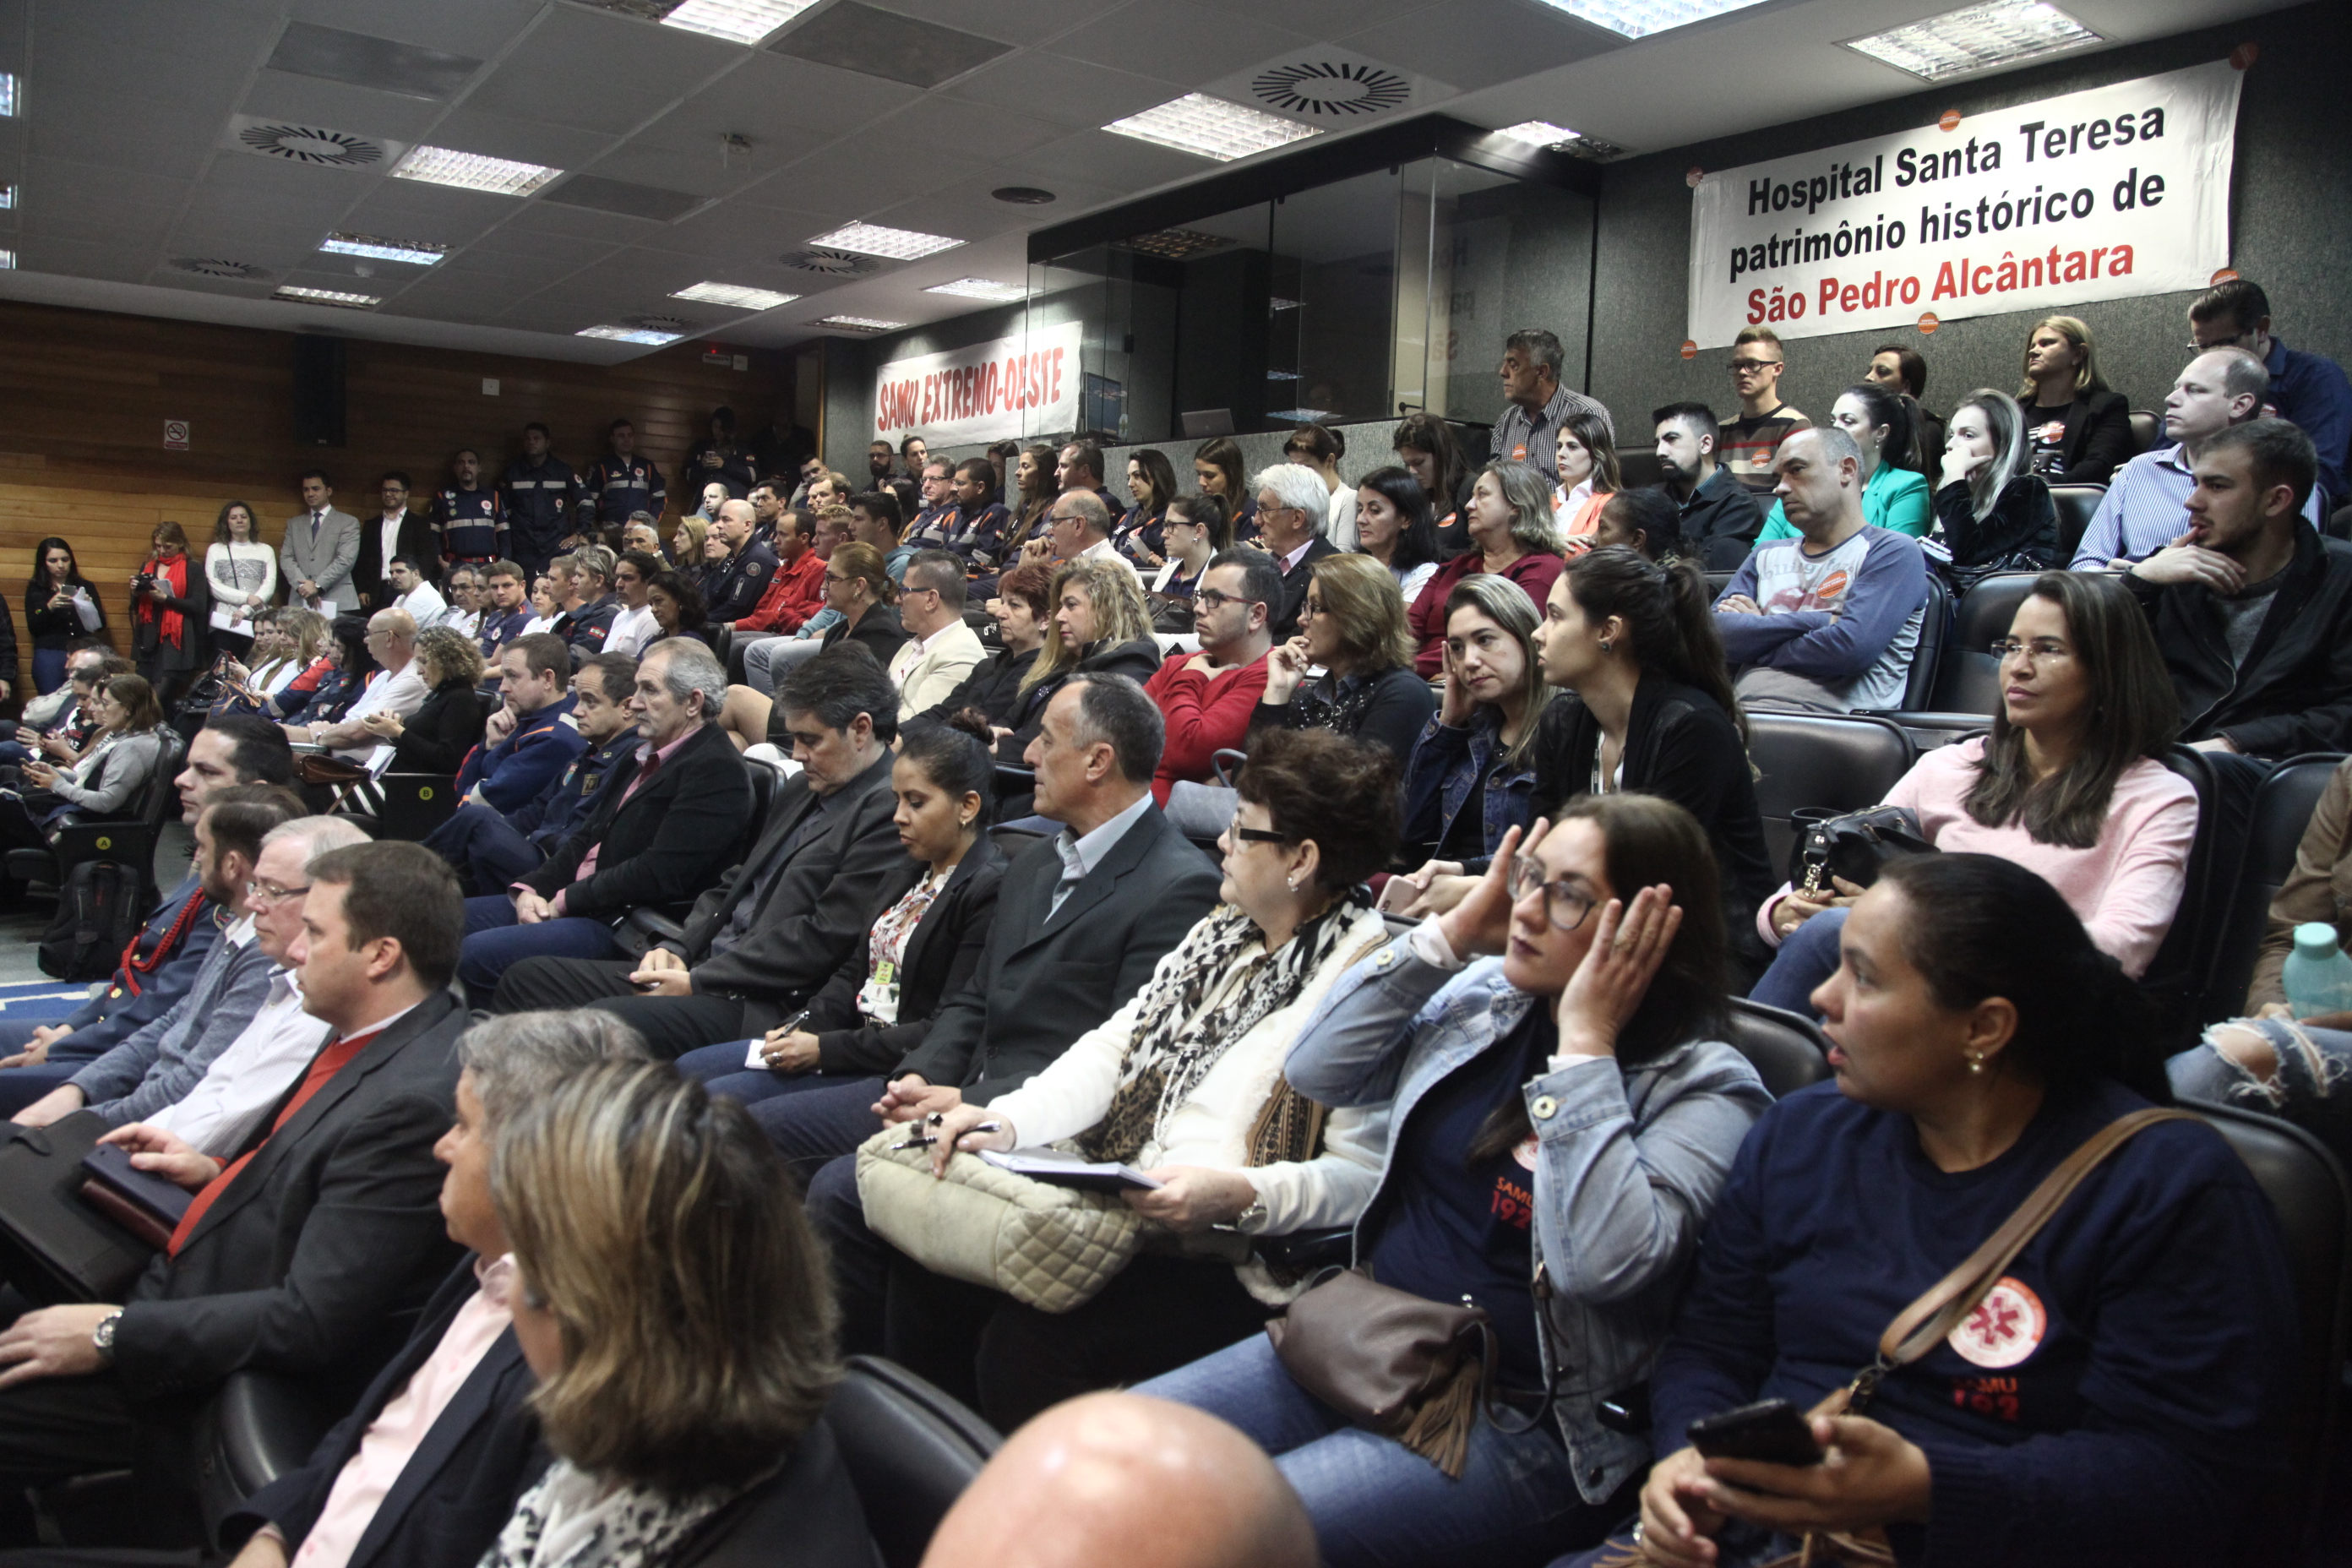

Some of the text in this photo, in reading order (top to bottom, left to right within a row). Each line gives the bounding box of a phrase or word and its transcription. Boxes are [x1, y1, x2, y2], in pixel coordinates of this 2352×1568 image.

[1748, 107, 2164, 215] Hospital Santa Teresa
[1729, 167, 2165, 284] patrimônio histórico de
[1746, 244, 2135, 325] São Pedro Alcântara
[878, 347, 1064, 432] SAMU EXTREMO-OESTE
[1491, 1190, 1533, 1229] 192
